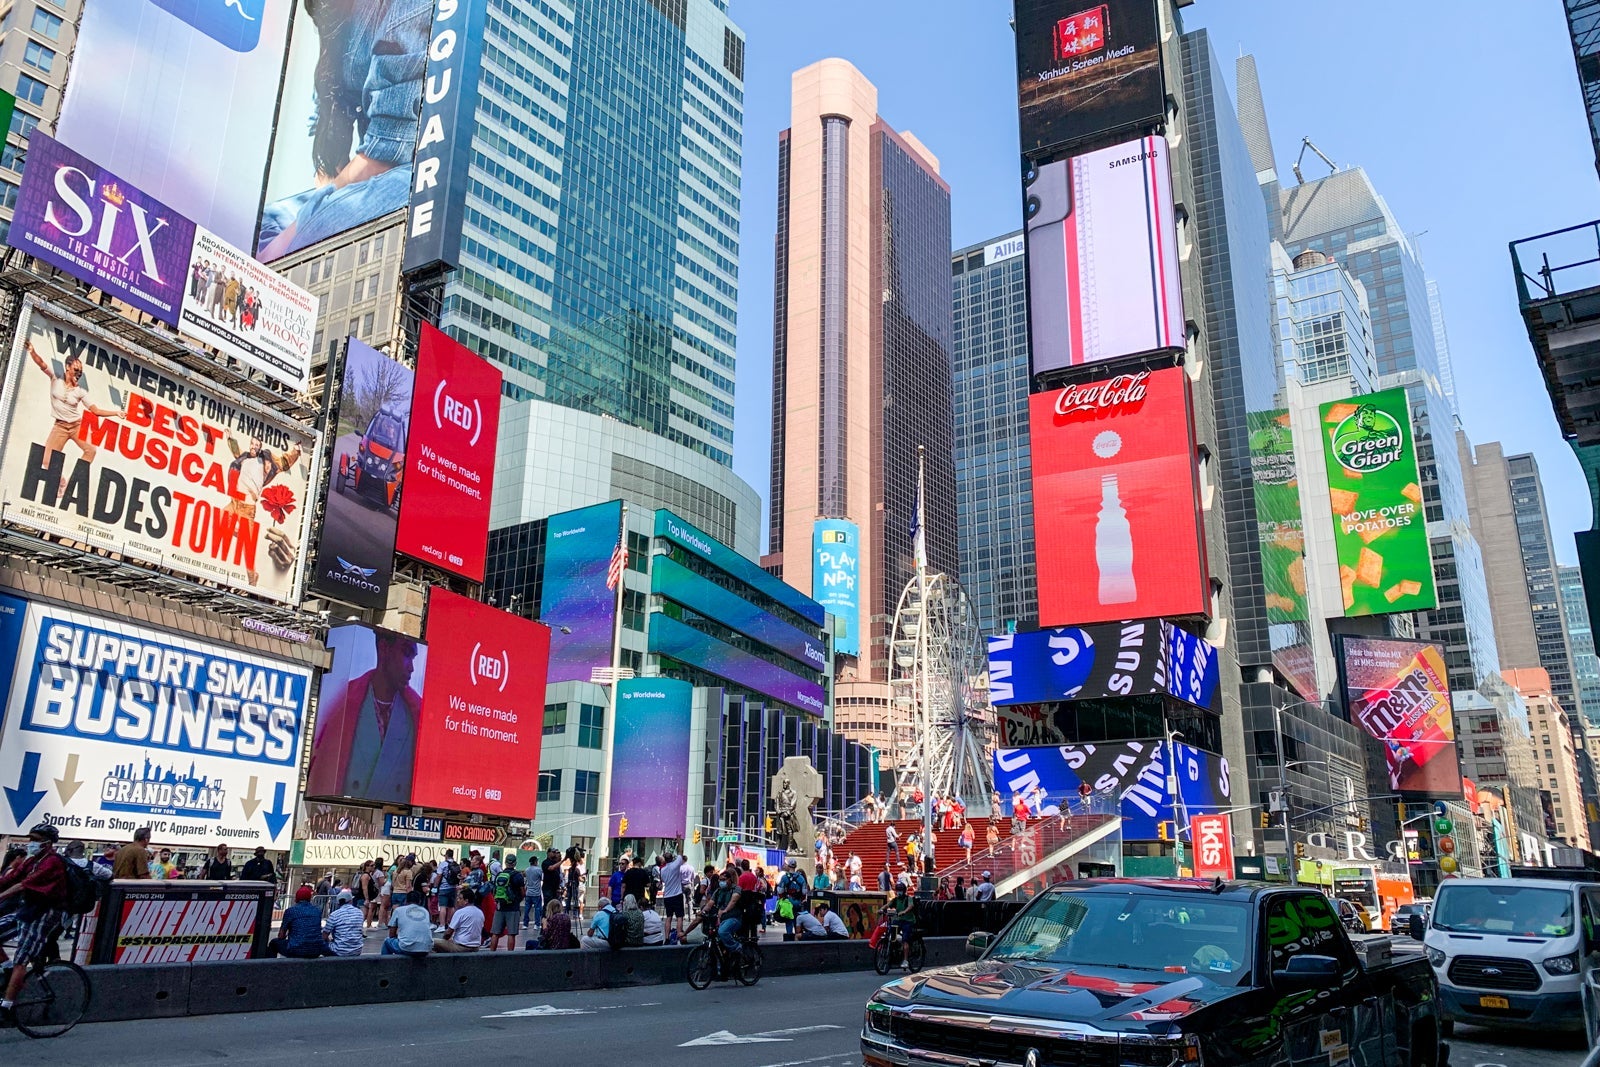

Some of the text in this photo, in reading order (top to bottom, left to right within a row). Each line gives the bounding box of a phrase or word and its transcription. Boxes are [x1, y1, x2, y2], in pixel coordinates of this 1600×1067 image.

[1038, 45, 1135, 82] Xinhua Screen Media
[1109, 150, 1158, 169] SAMSUNG
[44, 166, 168, 285] SIX
[69, 236, 141, 285] THE MUSICAL
[75, 256, 95, 272] THEATRE
[196, 241, 312, 313] AND INTERNATIONAL PHENOMENON
[246, 261, 277, 284] FUNNIEST
[278, 279, 299, 297] SMASH
[300, 293, 310, 304] HIT
[264, 307, 311, 341] THAT GOES
[269, 300, 309, 327] THE PLAY
[196, 317, 210, 330] NEW
[211, 324, 232, 343] WORLD
[232, 336, 252, 351] STAGES
[254, 349, 265, 359] 340
[282, 362, 302, 376] STREET
[261, 316, 309, 356] WRONG
[54, 326, 290, 451] WINNER! 8 TONY AWARDS
[1054, 371, 1150, 416] Coca-Cola
[126, 392, 224, 456] BEST
[78, 409, 247, 502] MUSICAL
[1341, 435, 1399, 456] Green
[1350, 448, 1403, 469] Giant
[421, 443, 481, 484] We were made
[417, 460, 482, 501] for this moment.
[36, 512, 59, 525] MITCHELL
[1341, 504, 1415, 523] MOVE OVER
[1346, 516, 1412, 534] POTATOES
[78, 524, 95, 537] RACHEL
[553, 526, 586, 539] Top Worldwide
[667, 519, 712, 555] Top Worldwide
[128, 539, 162, 555] HADESTOWN.COM
[177, 556, 191, 565] WALTER
[422, 543, 443, 560] red.org
[326, 569, 381, 595] ARCIMOTO
[804, 641, 826, 665] Xiaomi
[1350, 648, 1363, 656] Hear
[1363, 649, 1373, 657] the
[44, 624, 298, 710] SUPPORT SMALL
[1426, 667, 1443, 692] SHARE
[622, 691, 665, 700] Top Worldwide
[31, 664, 297, 761] BUSINESS
[449, 695, 518, 724] We were made
[1405, 708, 1424, 728] CLASSIC
[1420, 694, 1440, 714] MIX
[445, 715, 519, 745] for this moment.
[452, 784, 477, 800] red.org
[42, 812, 260, 839] Sports Fan Shop NYC Apparel Souvenirs
[391, 815, 441, 832] BLUE FIN
[446, 824, 496, 842] DOS CAMINOS
[305, 844, 379, 860] SWAROVSKI
[1200, 819, 1224, 867] tkts
[1344, 831, 1378, 860] R
[122, 901, 257, 936] HATE HAS NO
[120, 933, 251, 945] #STOPASIANHATE
